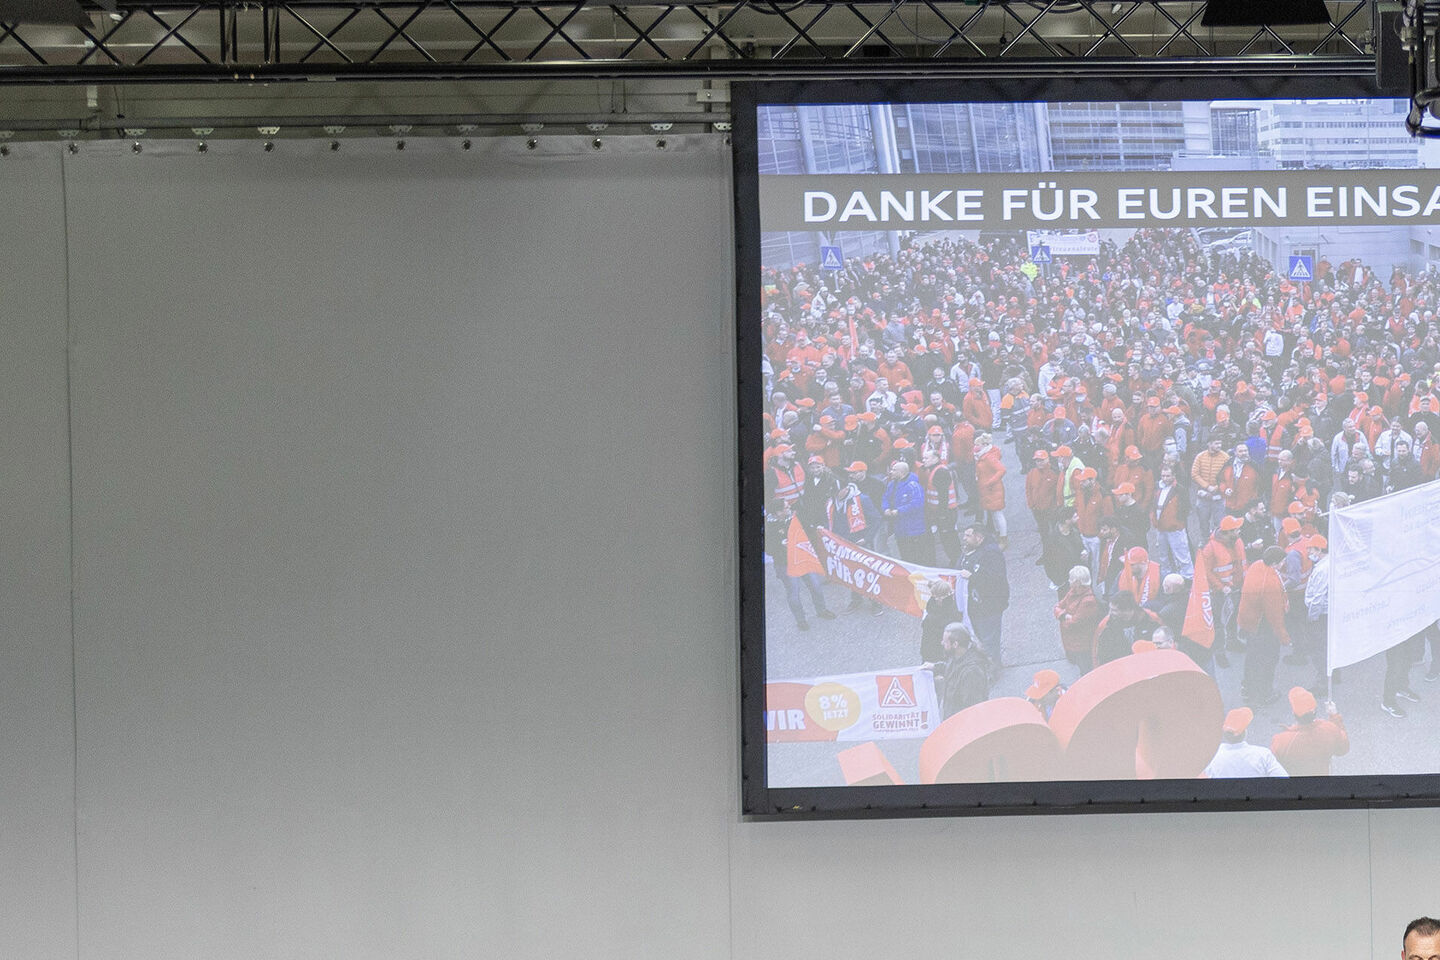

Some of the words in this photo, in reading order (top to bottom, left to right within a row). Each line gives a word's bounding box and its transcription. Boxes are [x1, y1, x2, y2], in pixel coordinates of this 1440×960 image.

[803, 190, 985, 223] DANKE
[1002, 181, 1101, 221] FÜR
[1118, 187, 1287, 220] EUREN
